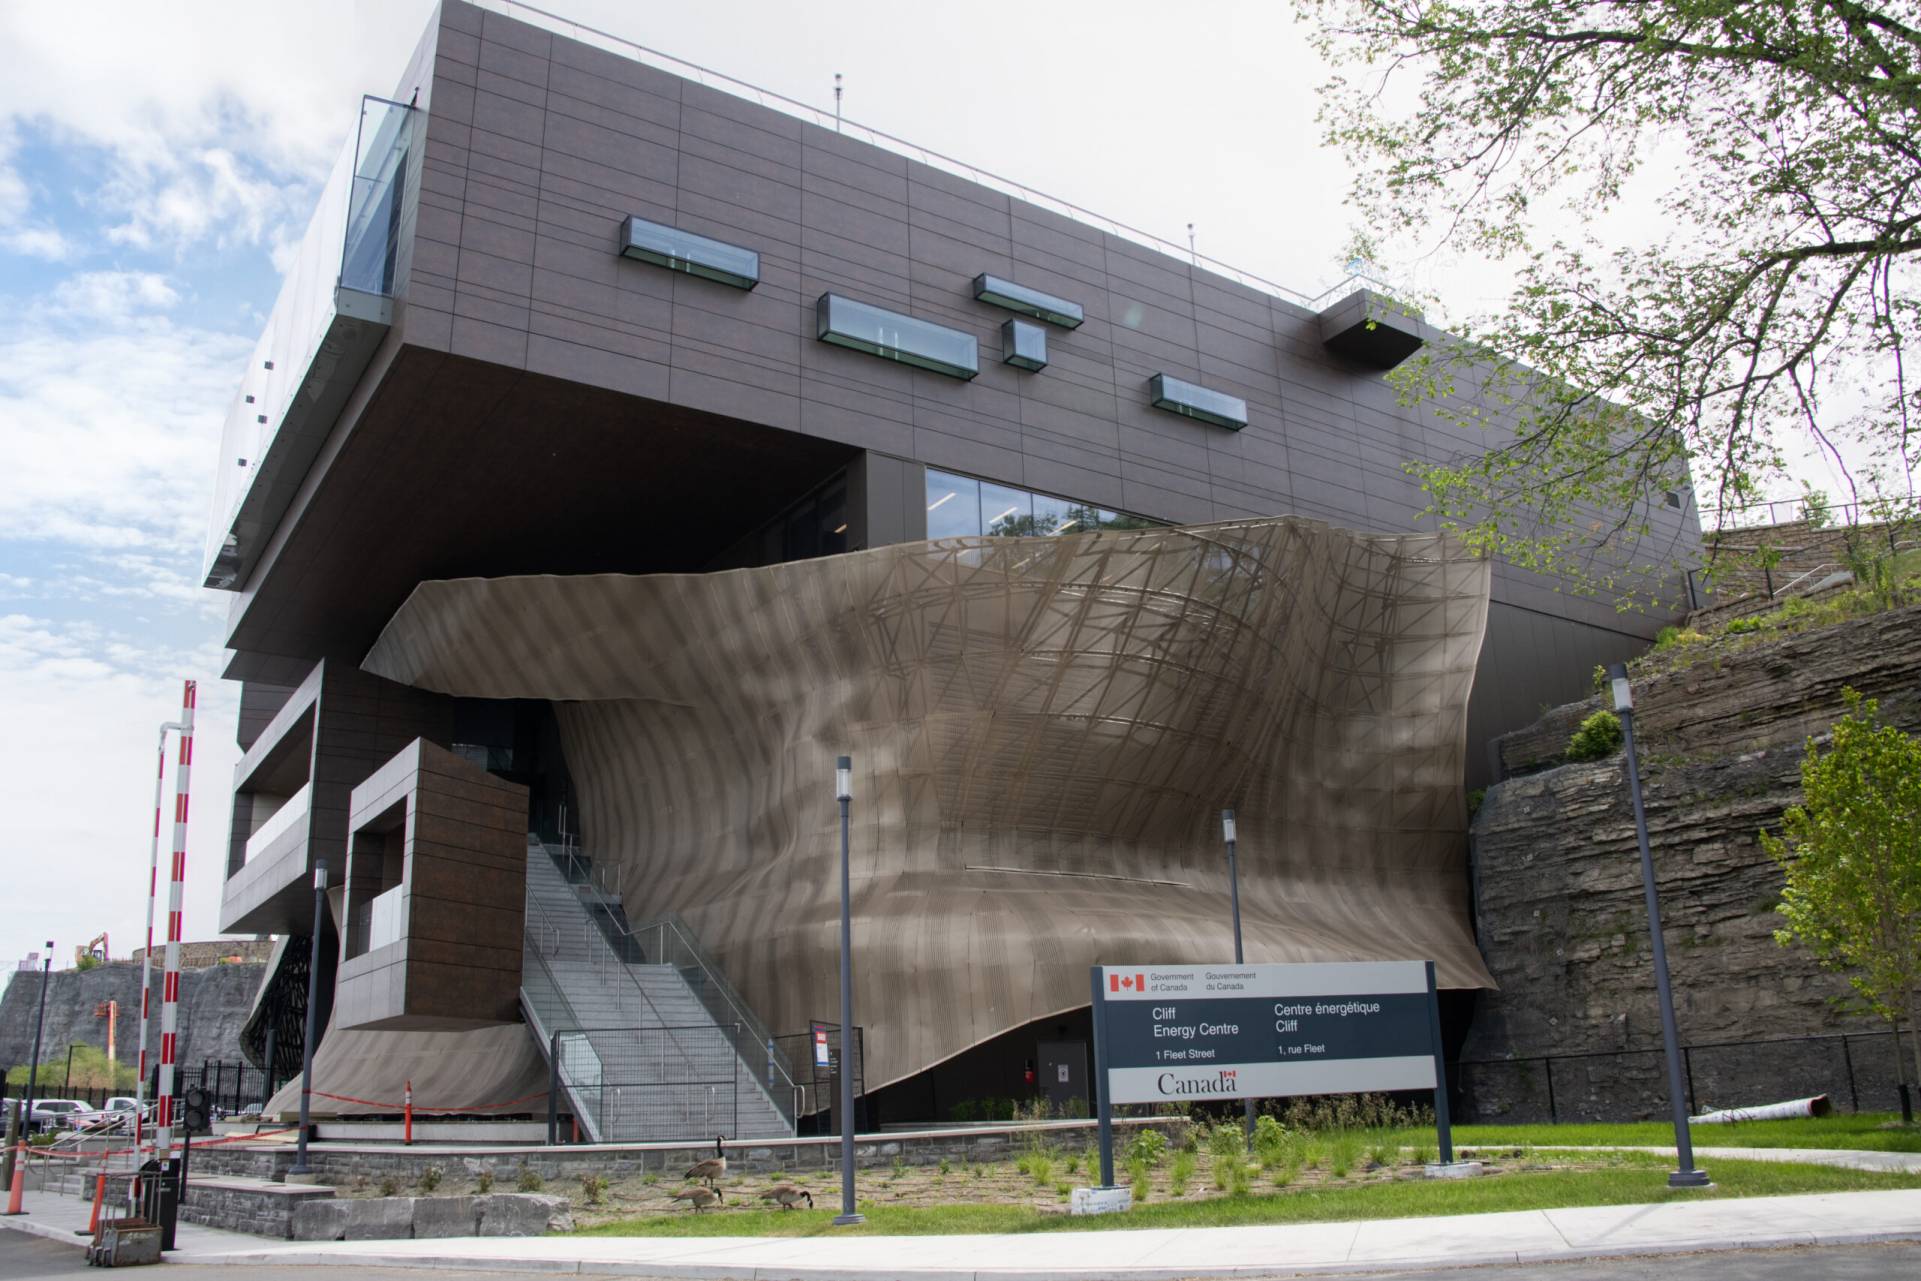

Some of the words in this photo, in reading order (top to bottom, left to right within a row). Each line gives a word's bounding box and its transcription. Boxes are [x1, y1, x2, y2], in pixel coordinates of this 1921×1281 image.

[1151, 973, 1194, 981] Government
[1205, 972, 1256, 980] Gouvernement
[1152, 1007, 1176, 1020] Cliff
[1274, 1004, 1312, 1016] Centre
[1316, 1002, 1380, 1016] énergétique
[1154, 1024, 1196, 1039] Energy
[1200, 1022, 1239, 1036] Centre
[1276, 1020, 1298, 1032] Cliff
[1156, 1051, 1160, 1060] 1
[1164, 1050, 1187, 1059] Fleet
[1188, 1049, 1215, 1058] Street
[1278, 1046, 1286, 1055] 1,
[1304, 1044, 1325, 1053] Fleet
[1158, 1071, 1236, 1095] Canada
